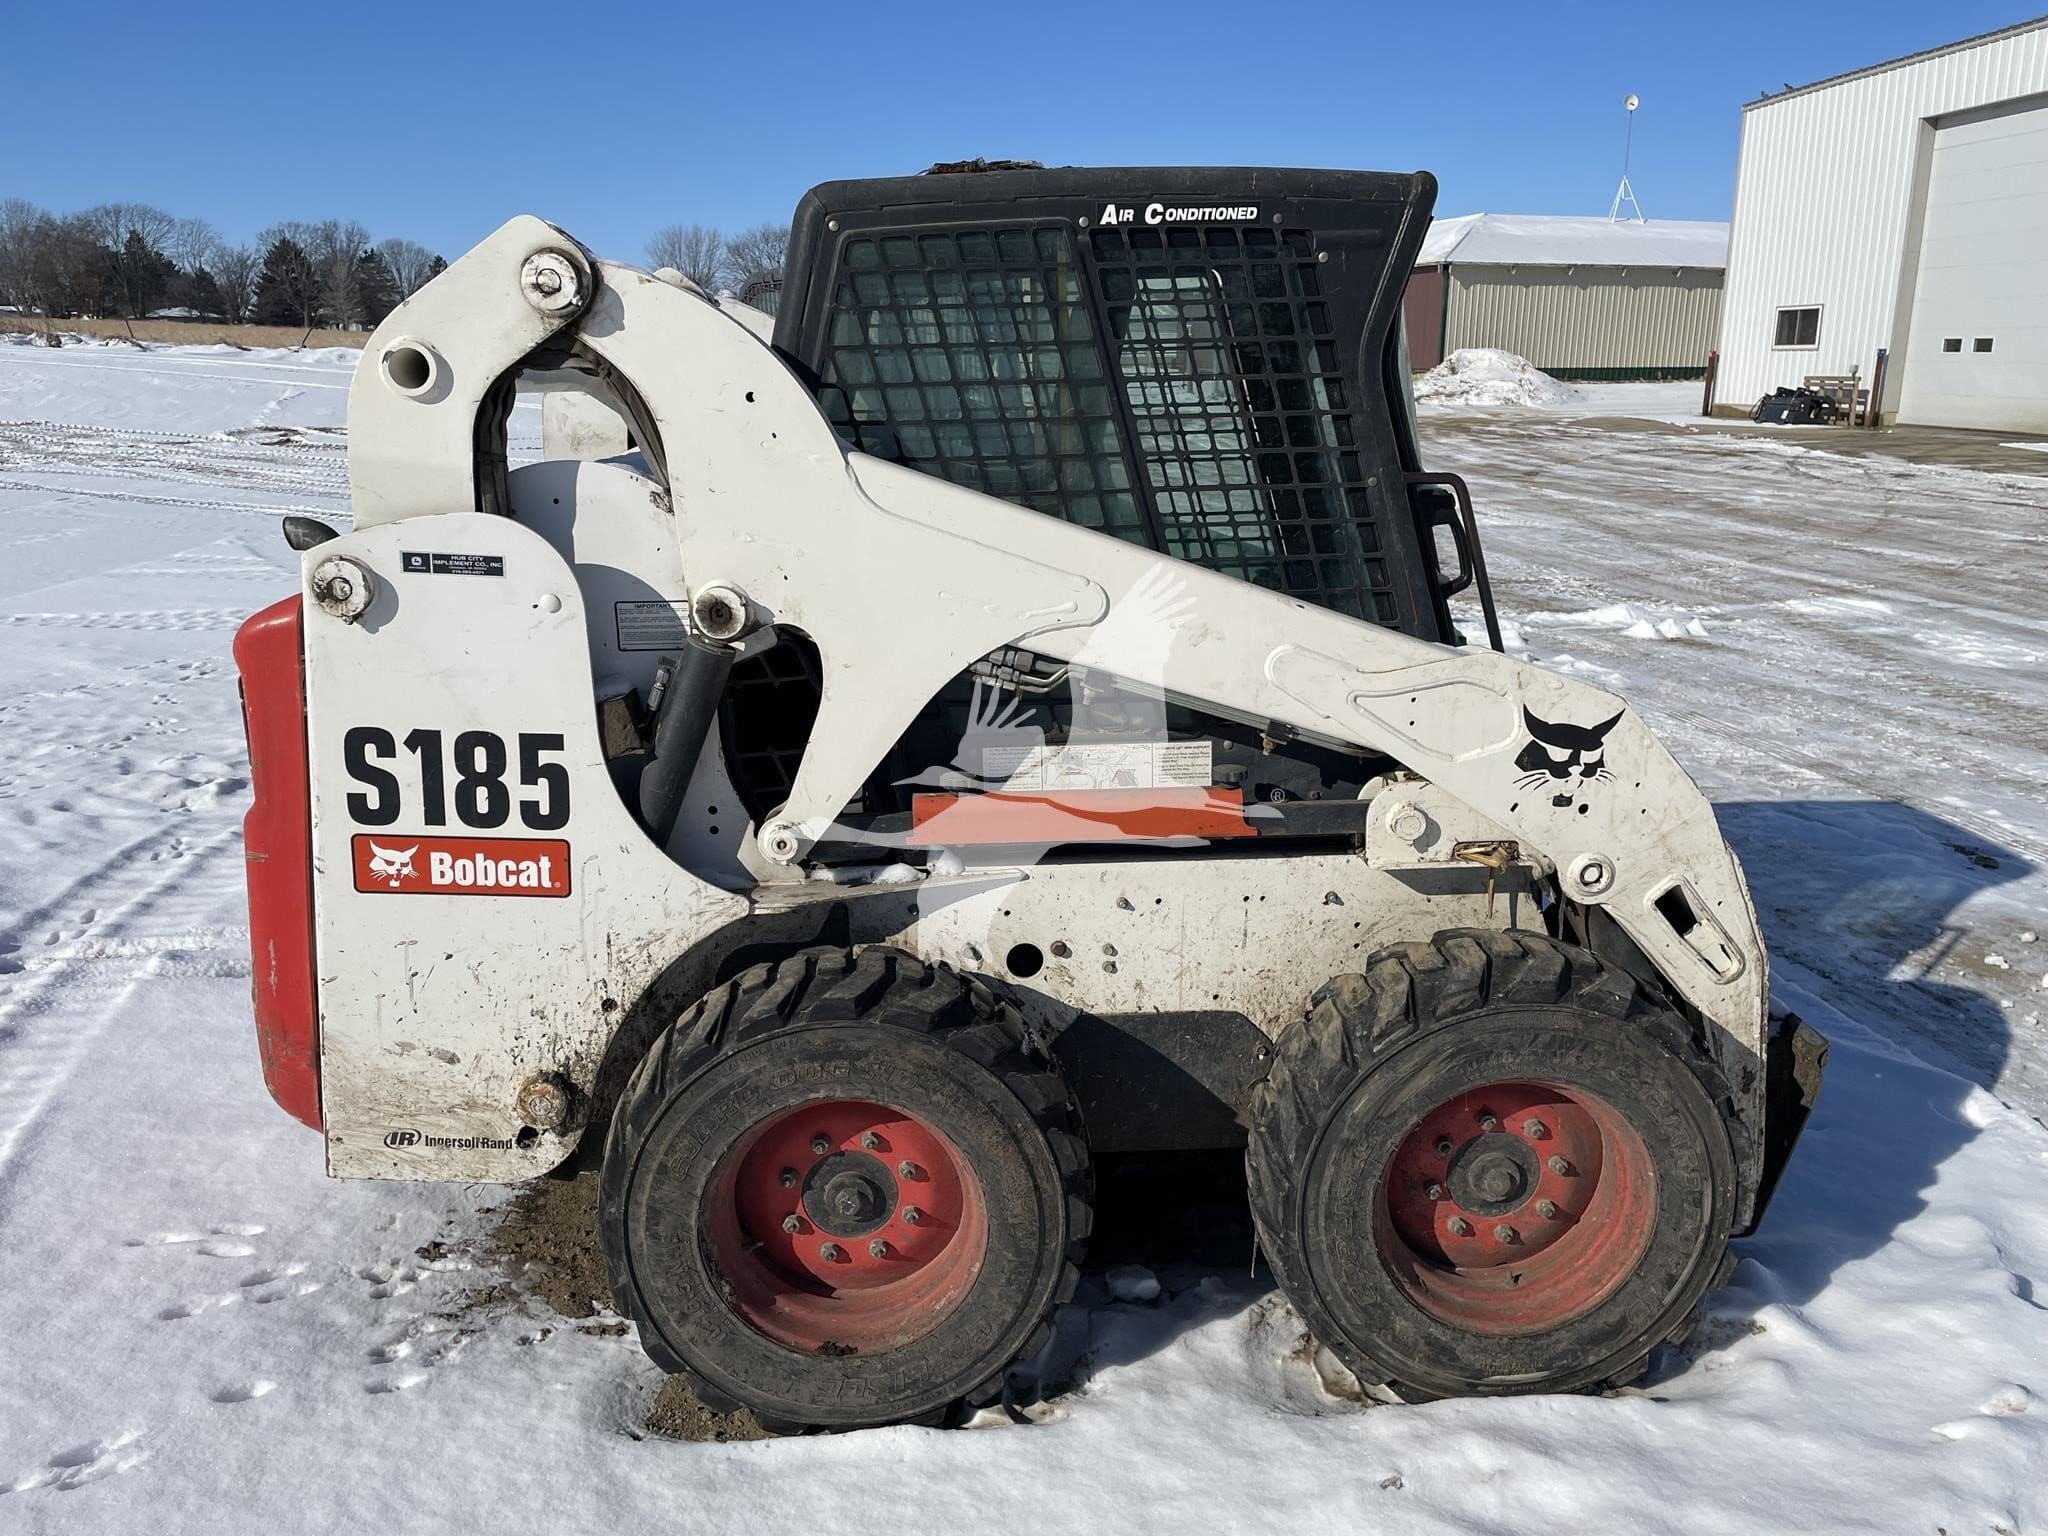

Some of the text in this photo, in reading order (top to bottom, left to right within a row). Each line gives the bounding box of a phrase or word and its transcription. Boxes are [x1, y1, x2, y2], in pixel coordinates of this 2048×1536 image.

[1100, 203, 1258, 225] AIR CONDITIONED
[344, 726, 571, 831] S185
[430, 851, 553, 889] Bobcat
